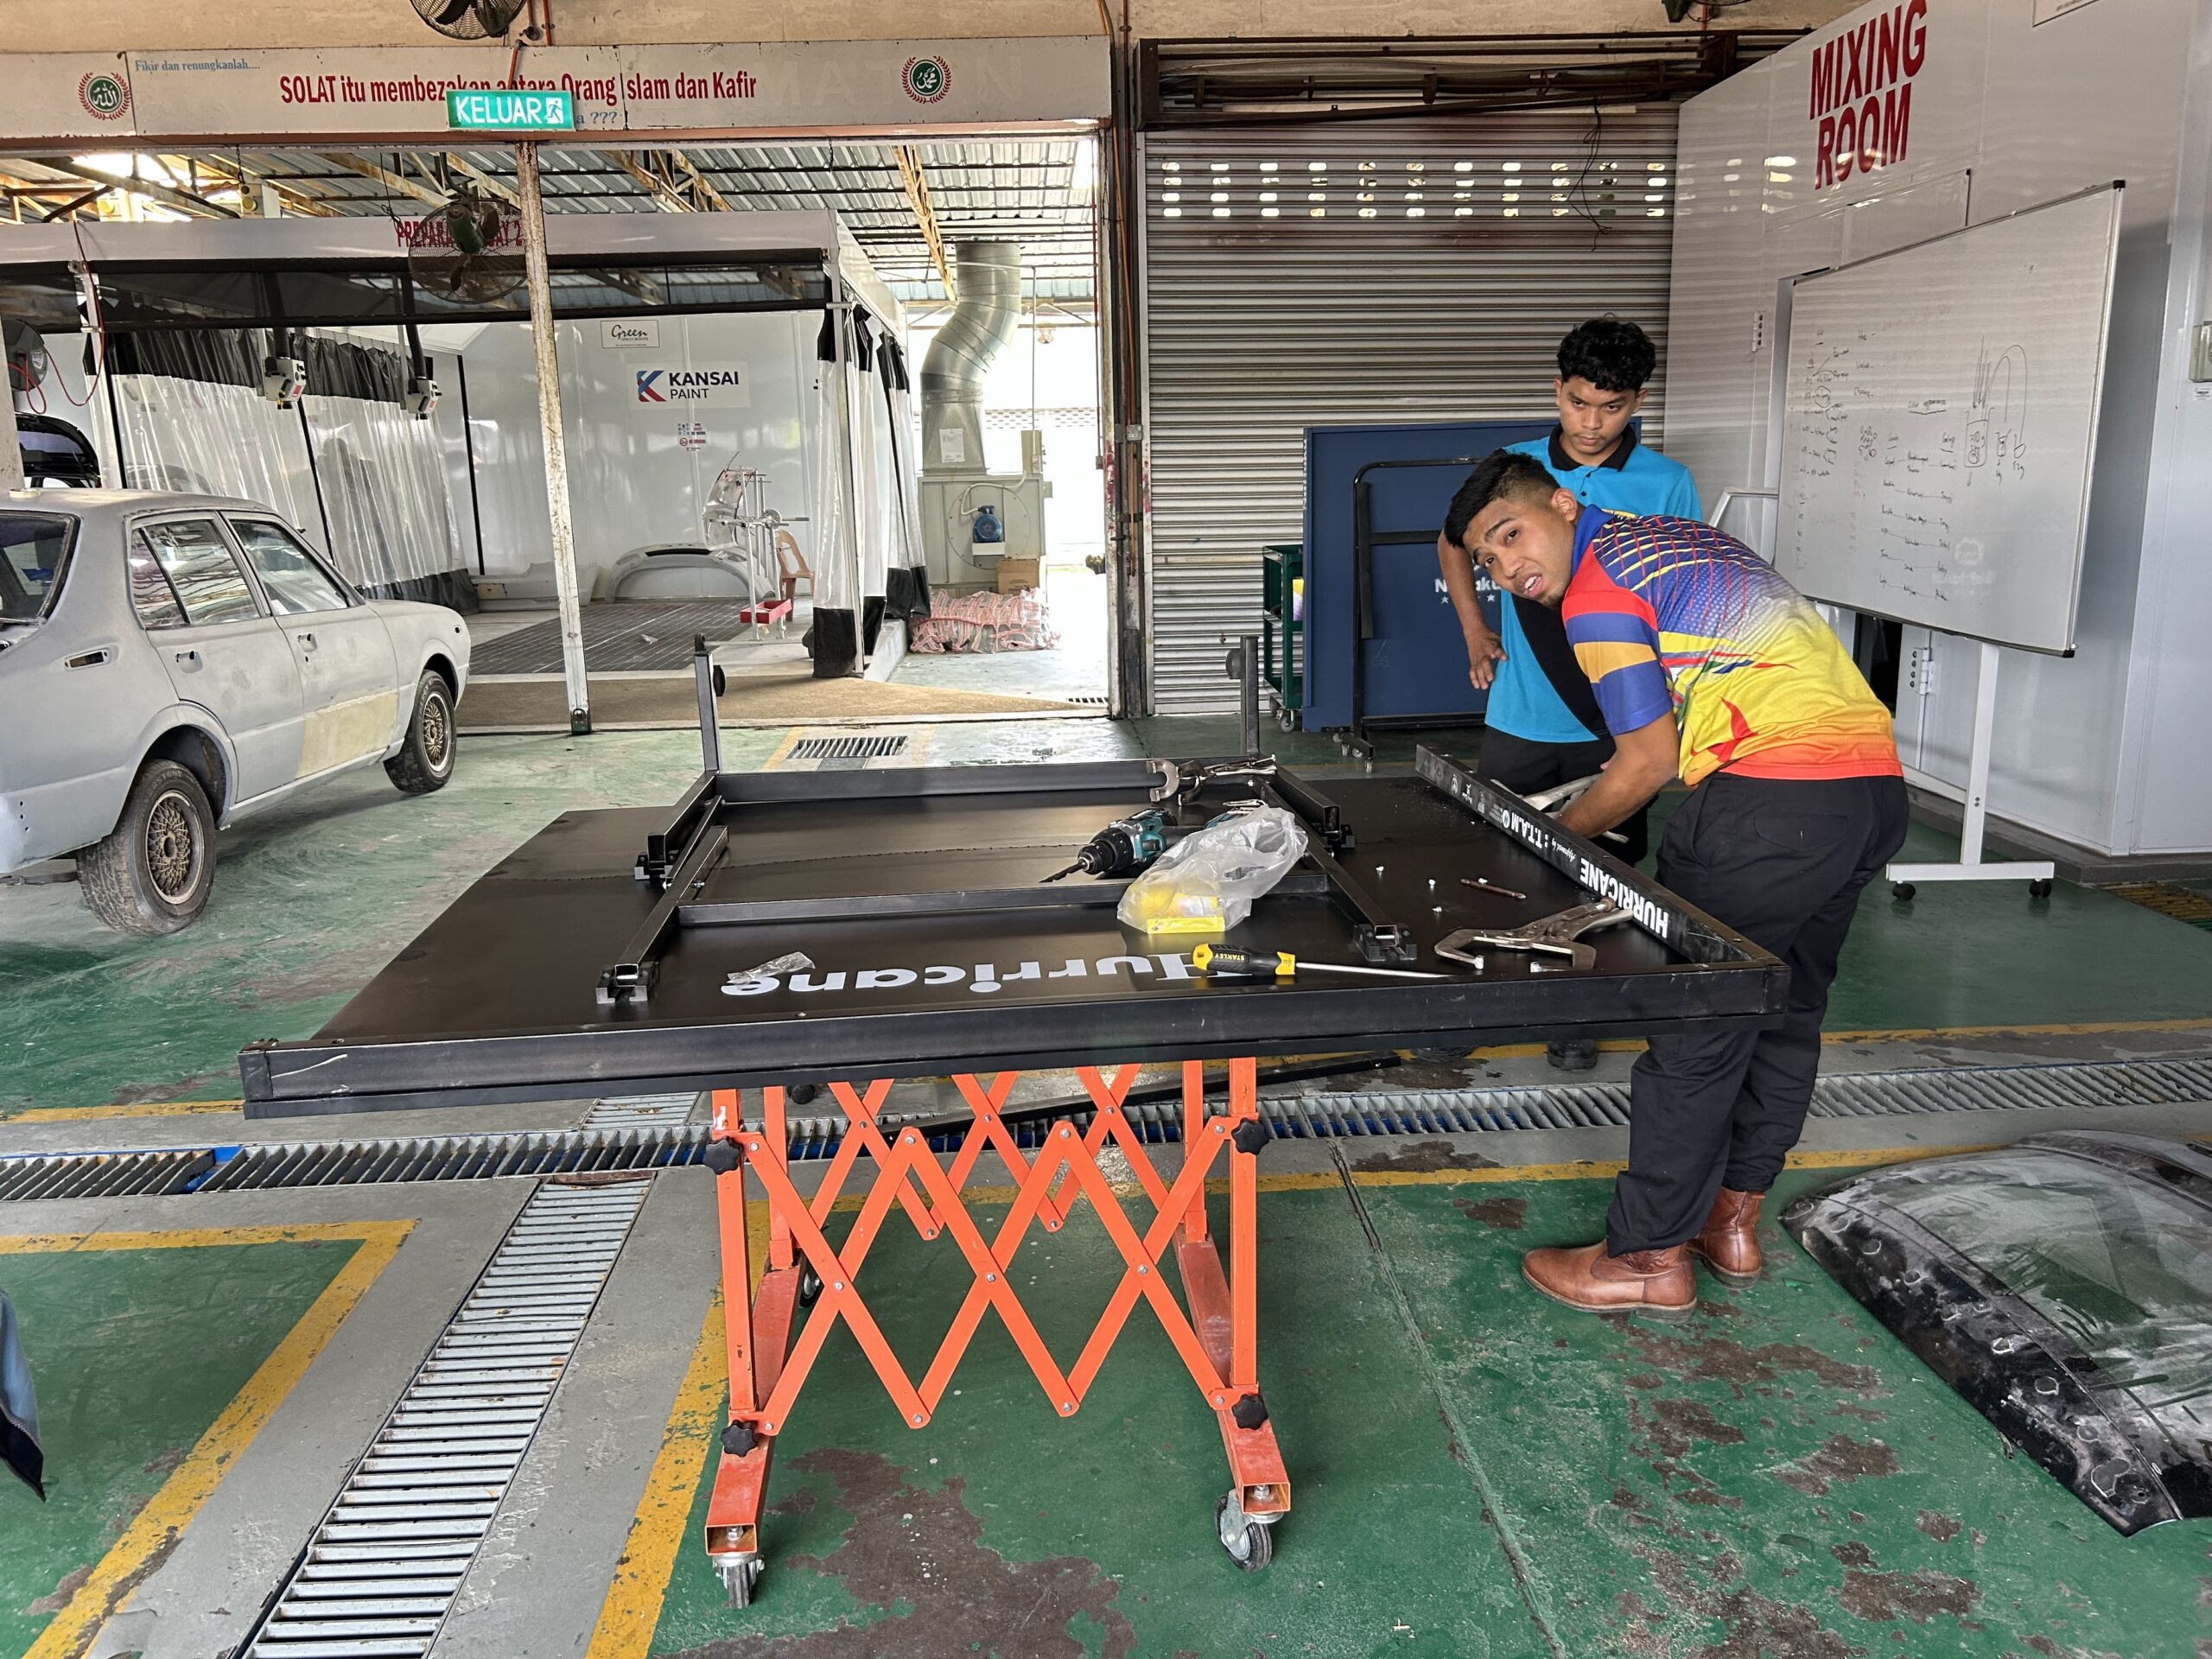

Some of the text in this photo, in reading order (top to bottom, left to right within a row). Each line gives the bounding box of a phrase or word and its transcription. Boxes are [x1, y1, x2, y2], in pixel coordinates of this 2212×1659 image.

[135, 60, 160, 72] Fikir
[162, 60, 179, 71] dan
[1809, 0, 1927, 120] MIXING
[279, 75, 336, 104] SOLAT
[340, 75, 365, 103] itu
[496, 74, 556, 91] atara
[562, 73, 617, 106] Orang
[675, 72, 709, 99] dan
[712, 70, 757, 99] Kafir
[454, 96, 542, 124] KELUAR
[1815, 82, 1912, 190] ROOM
[611, 324, 648, 340] Green
[669, 371, 740, 387] KANSAI
[670, 388, 710, 399] PAINT
[1580, 857, 1669, 938] HURRICANE
[1214, 952, 1245, 962] STANLEY
[721, 952, 1253, 996] Hurricane
